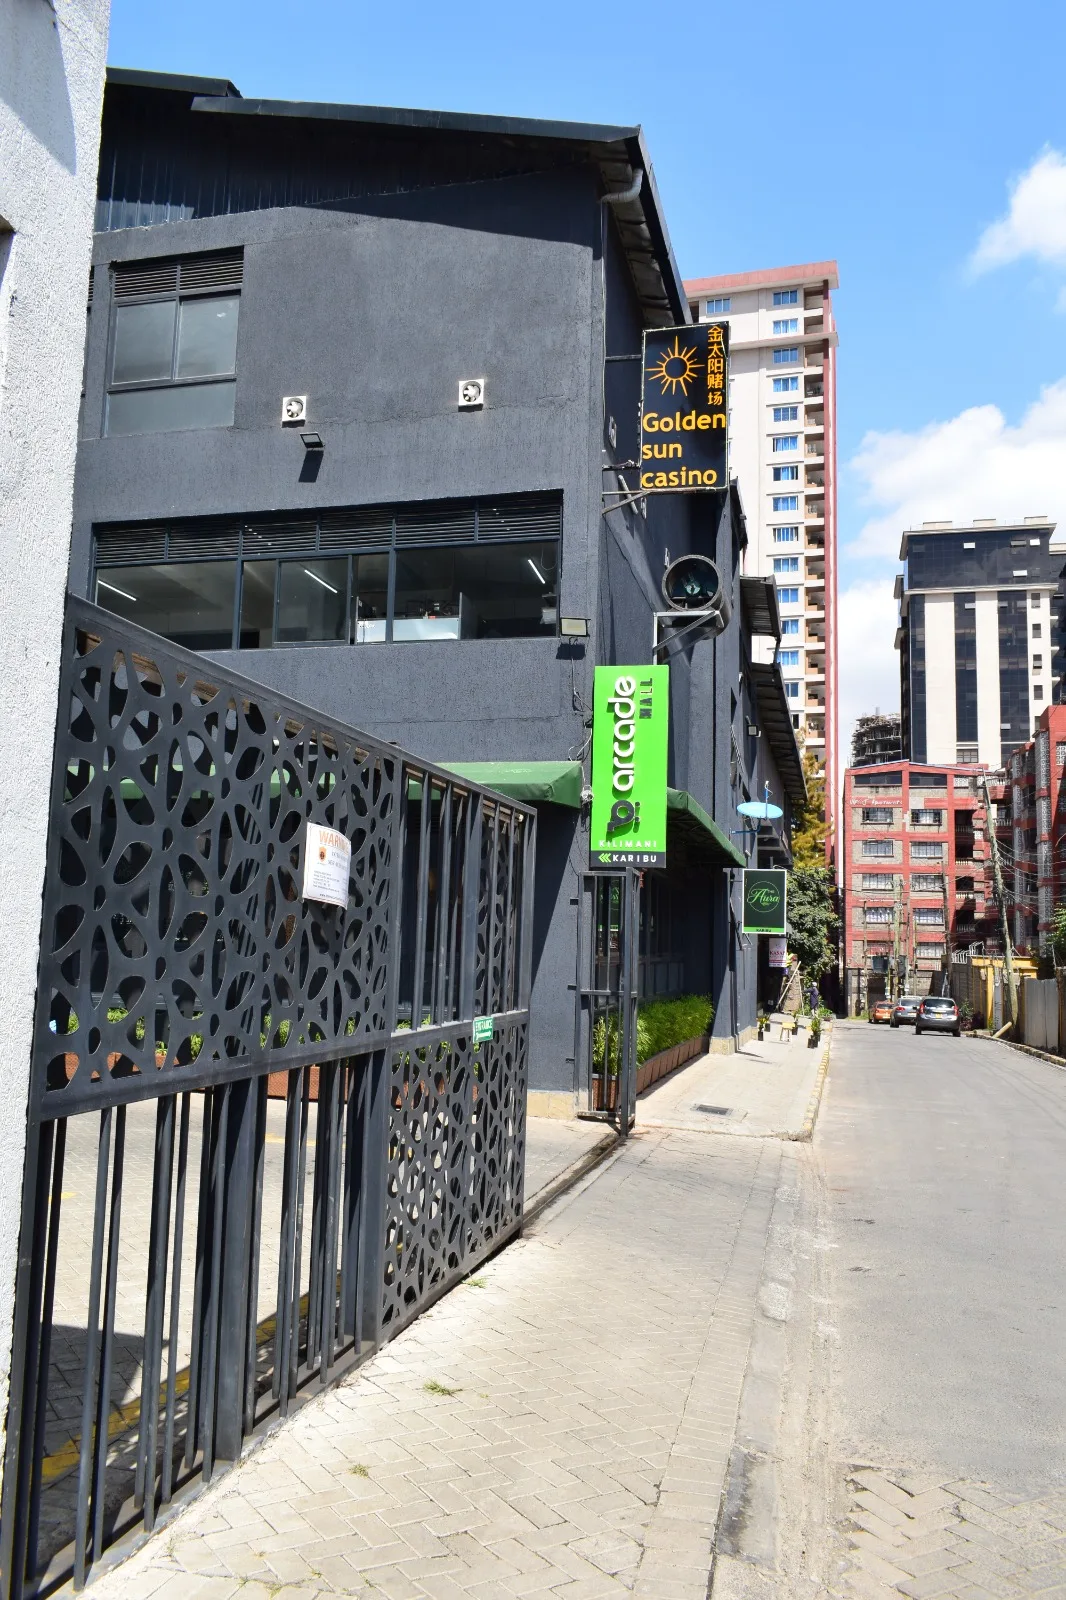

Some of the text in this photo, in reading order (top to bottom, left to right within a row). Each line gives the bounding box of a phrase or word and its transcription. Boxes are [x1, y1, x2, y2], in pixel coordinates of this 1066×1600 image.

[707, 325, 724, 406] 金太阳赌场
[642, 410, 726, 433] Golden
[642, 442, 683, 460] sun
[641, 466, 718, 488] casino
[639, 677, 653, 720] MALL
[607, 675, 637, 792] arcade
[599, 839, 657, 848] KILIMANI
[612, 853, 657, 863] KARIBU
